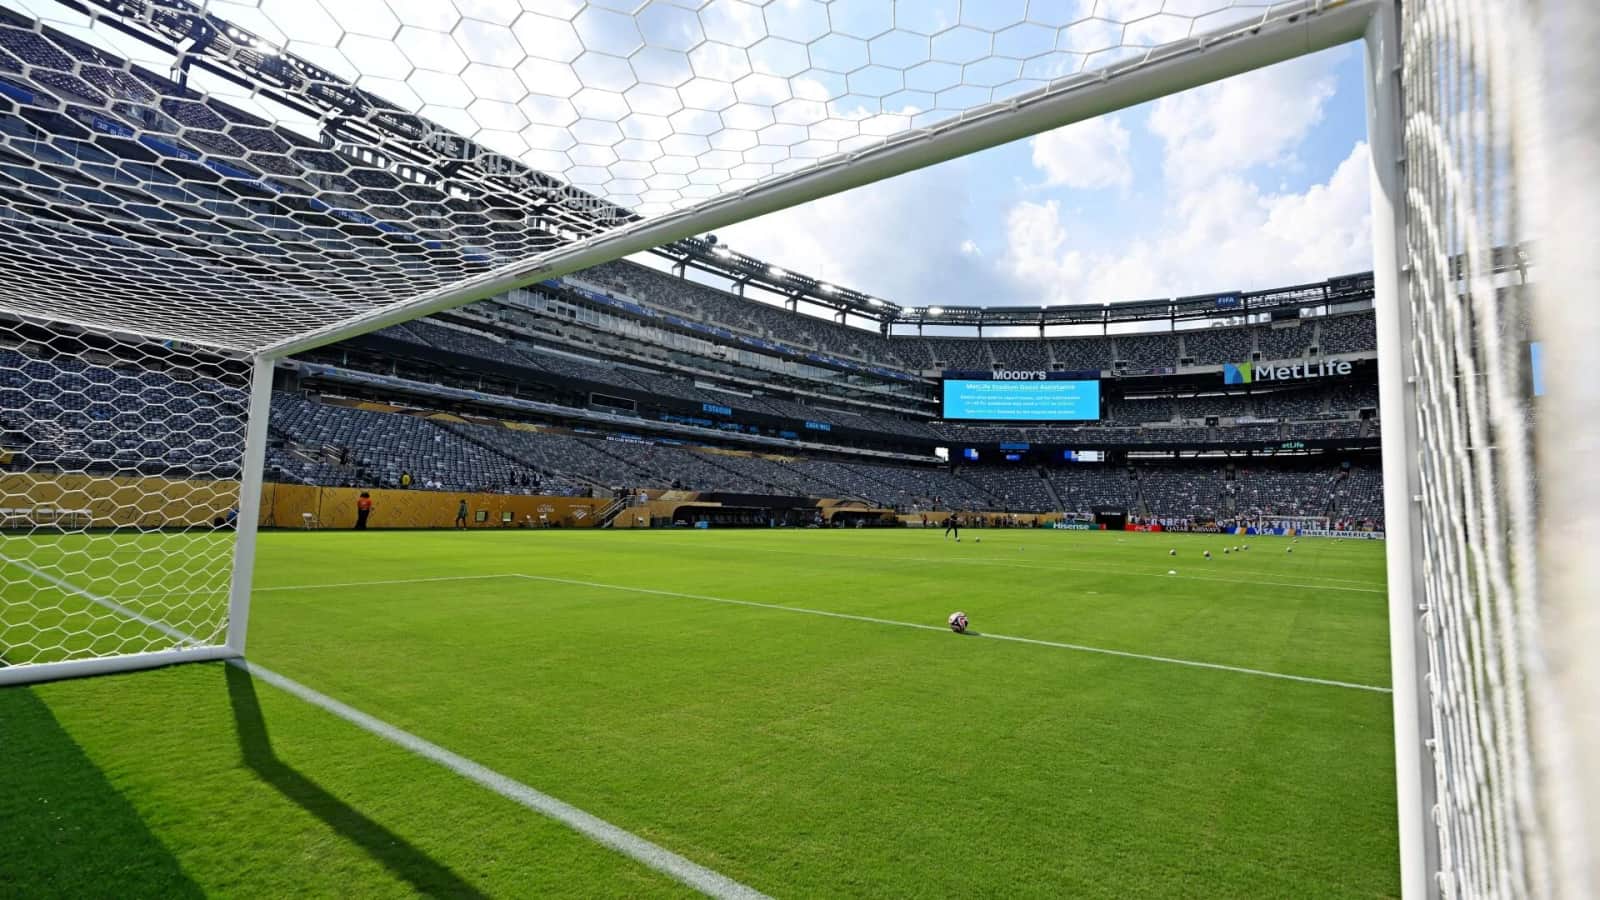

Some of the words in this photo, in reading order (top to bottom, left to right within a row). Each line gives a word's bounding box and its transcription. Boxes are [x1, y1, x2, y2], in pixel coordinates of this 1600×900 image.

[1256, 359, 1352, 381] MetLife
[993, 370, 1047, 380] MOODY'S
[1053, 522, 1090, 530] Hisense
[1254, 528, 1275, 536] VISA
